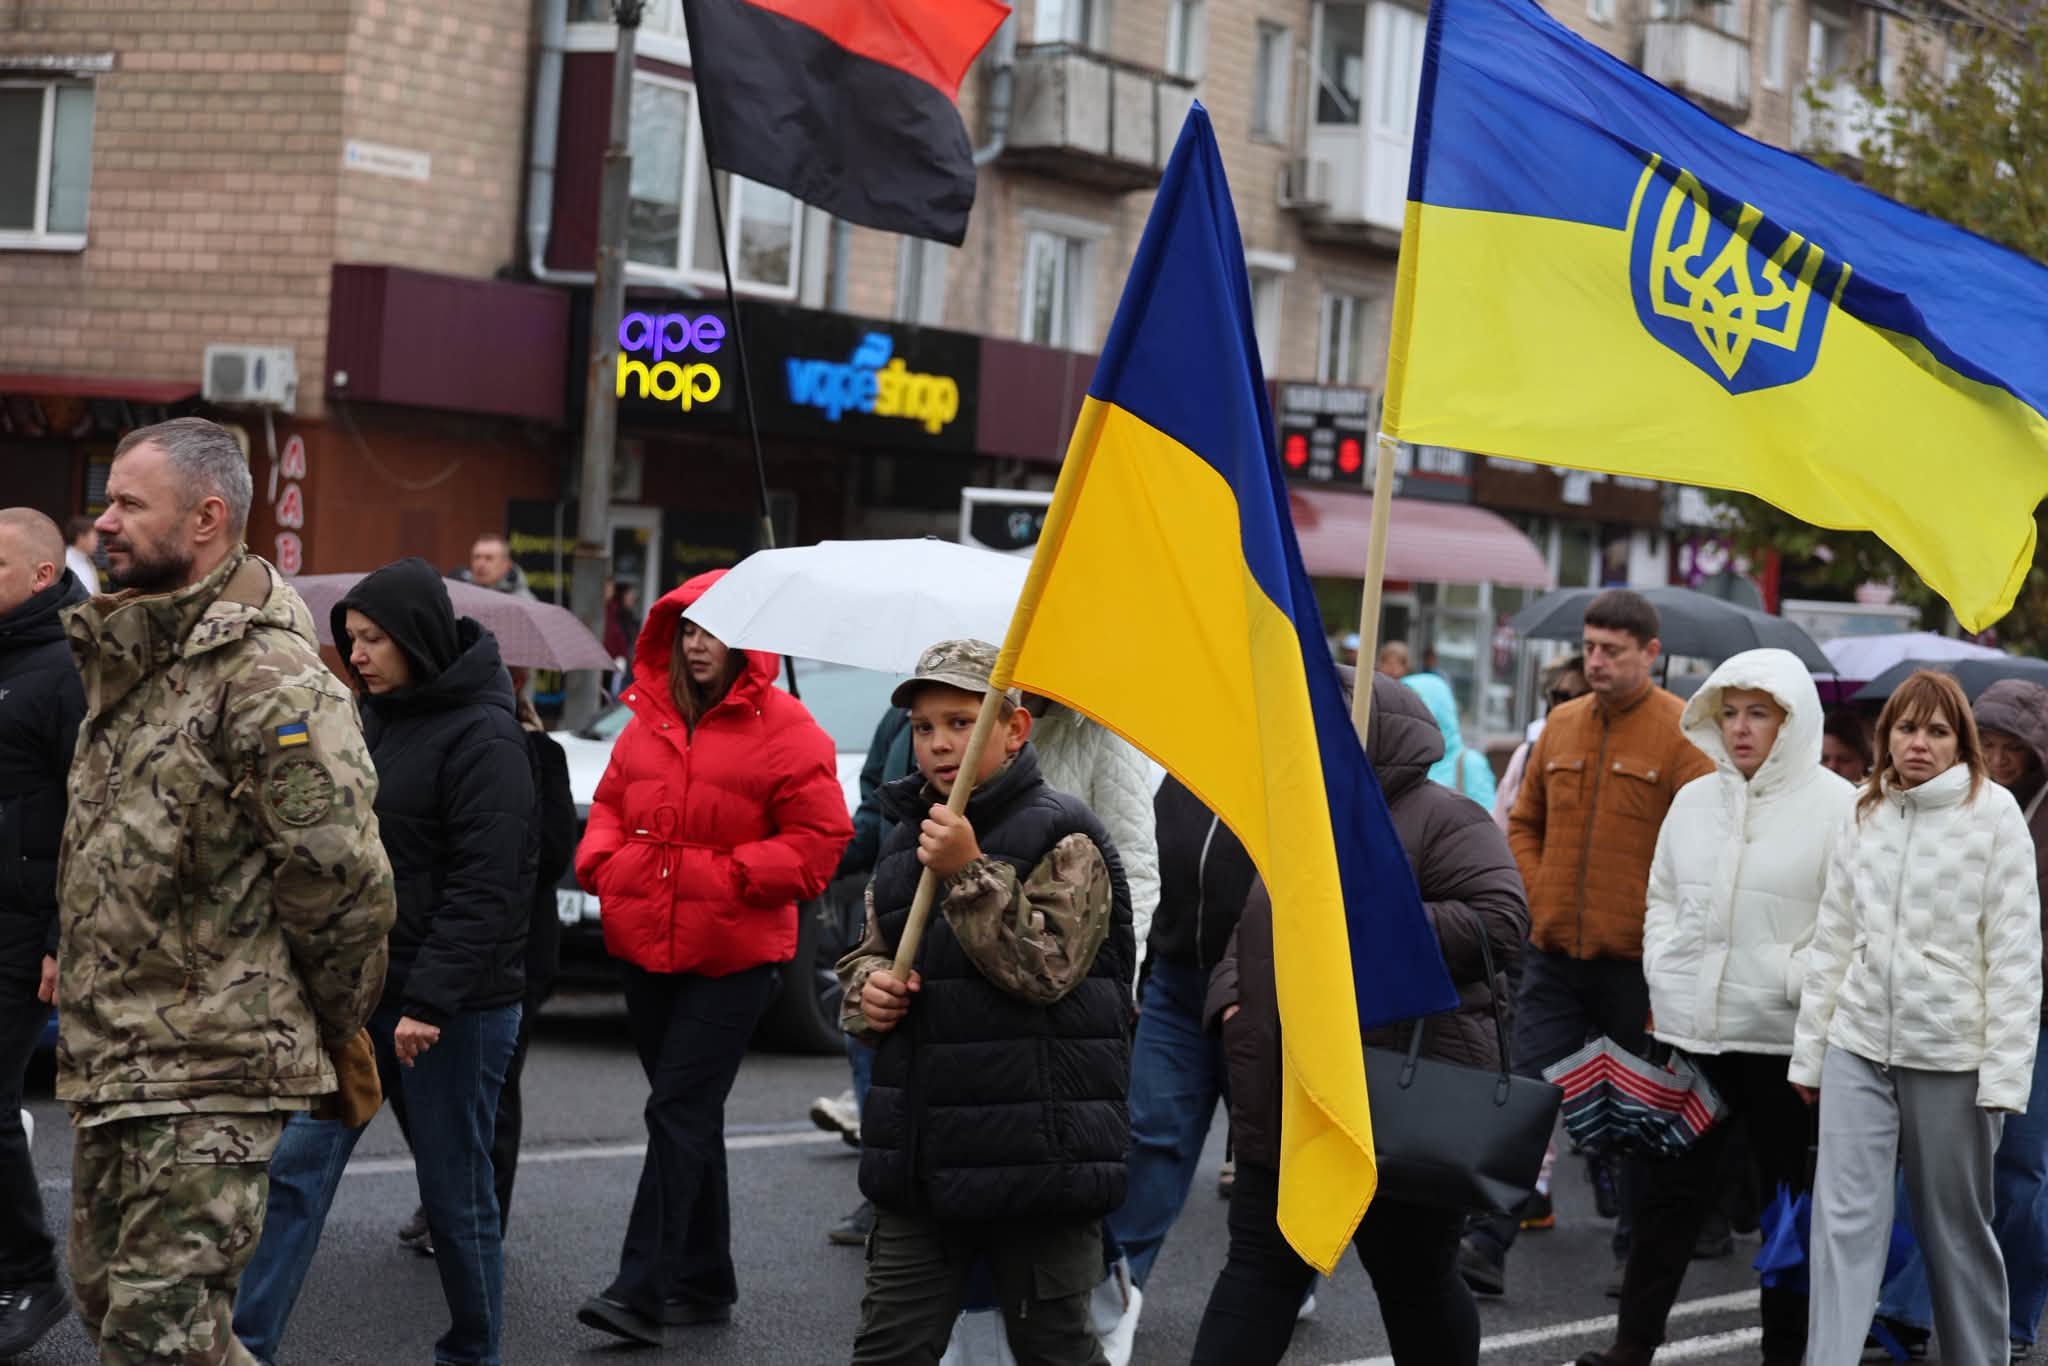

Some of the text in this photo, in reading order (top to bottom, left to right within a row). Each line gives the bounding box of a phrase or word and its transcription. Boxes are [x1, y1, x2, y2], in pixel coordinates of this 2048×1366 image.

[618, 311, 726, 362] ape
[615, 351, 721, 412] hop
[785, 356, 960, 435] vapeshop
